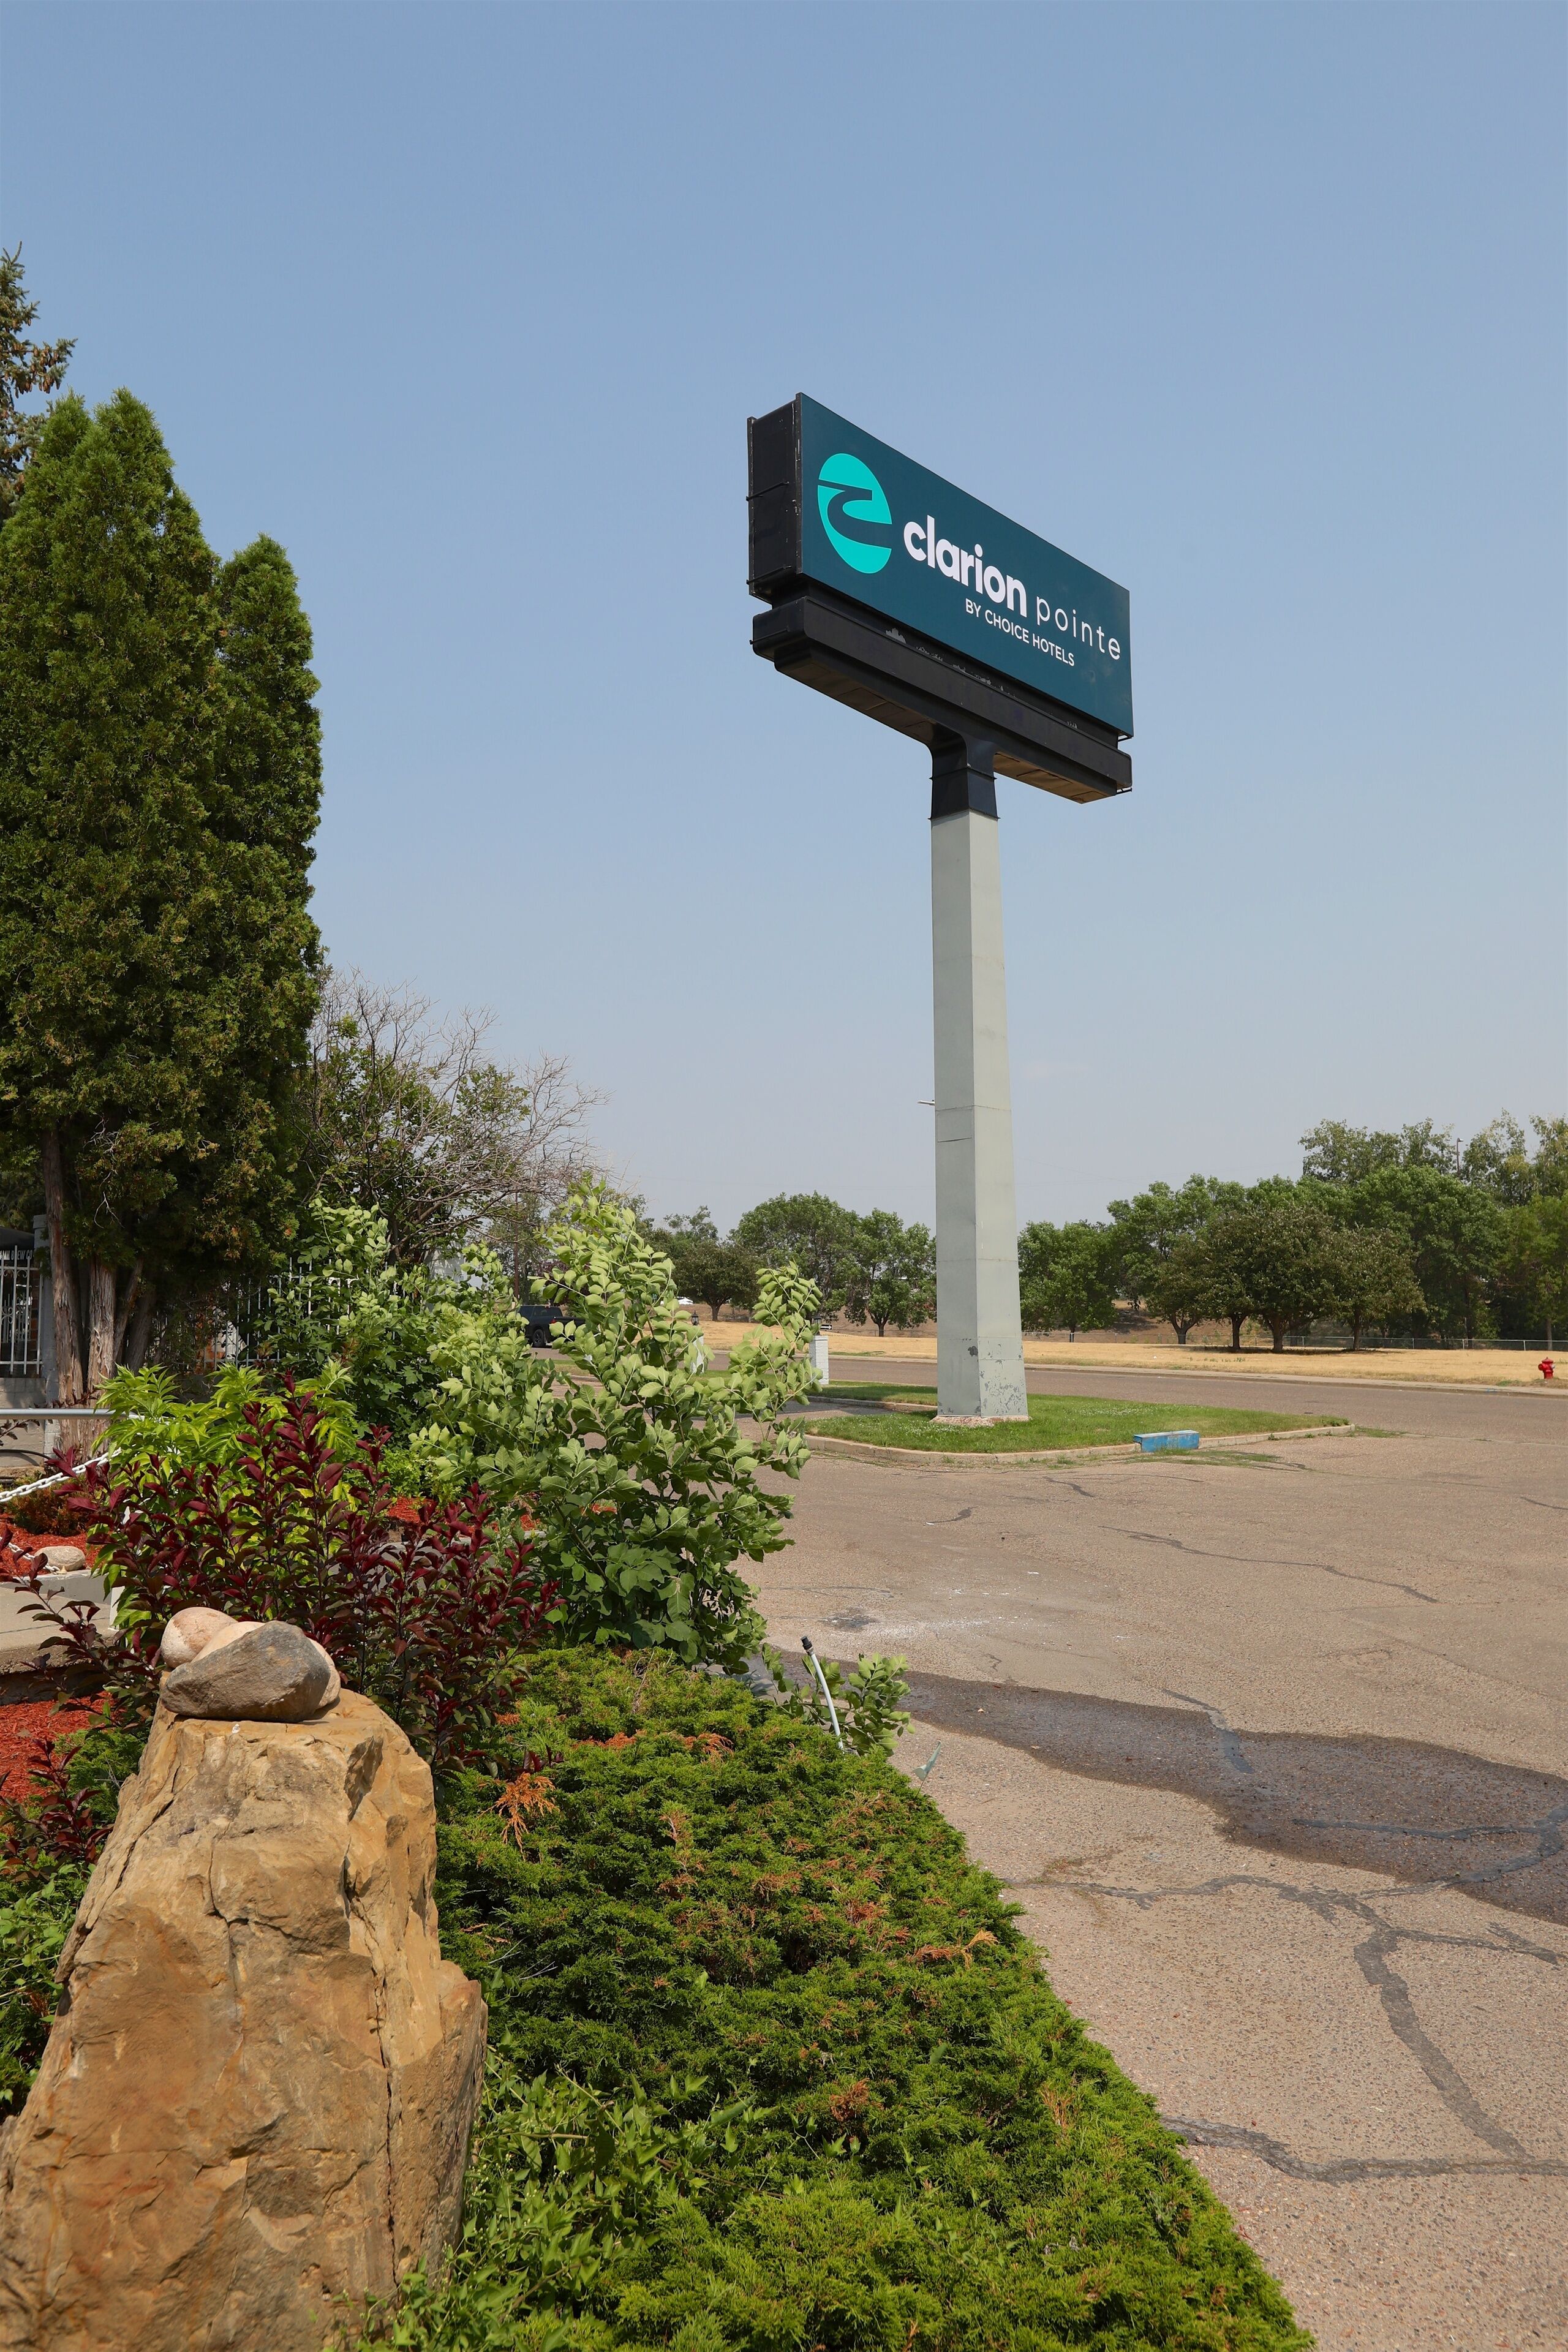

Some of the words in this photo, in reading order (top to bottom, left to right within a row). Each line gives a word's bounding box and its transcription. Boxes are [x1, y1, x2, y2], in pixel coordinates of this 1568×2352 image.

[903, 514, 1027, 617] clarion
[1036, 596, 1120, 660] pointe
[965, 598, 981, 617] BY
[985, 609, 1029, 644] CHOICE
[1033, 633, 1074, 666] HOTELS
[11, 1250, 26, 1260] BEW
